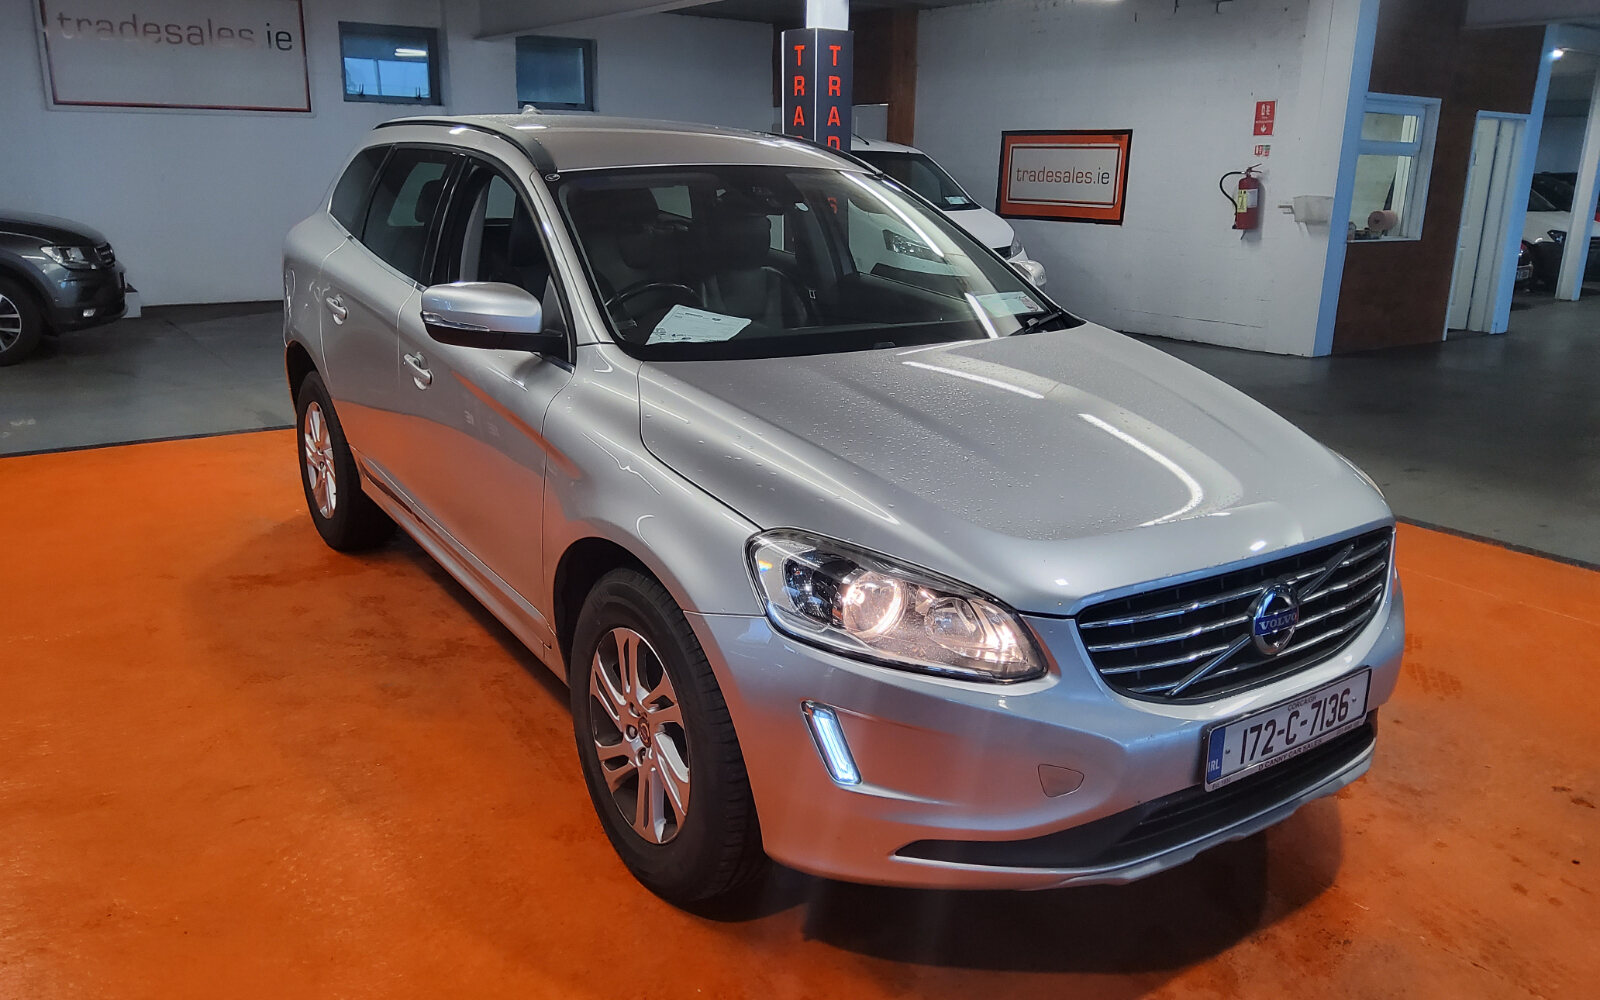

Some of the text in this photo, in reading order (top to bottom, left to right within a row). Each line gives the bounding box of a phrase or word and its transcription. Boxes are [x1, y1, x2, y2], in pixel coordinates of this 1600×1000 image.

[793, 44, 806, 139] TRA
[1016, 166, 1110, 184] tradesales.ie
[1259, 611, 1297, 630] VOLVO
[1240, 687, 1351, 765] 172-C-7136
[1208, 758, 1220, 773] IRL
